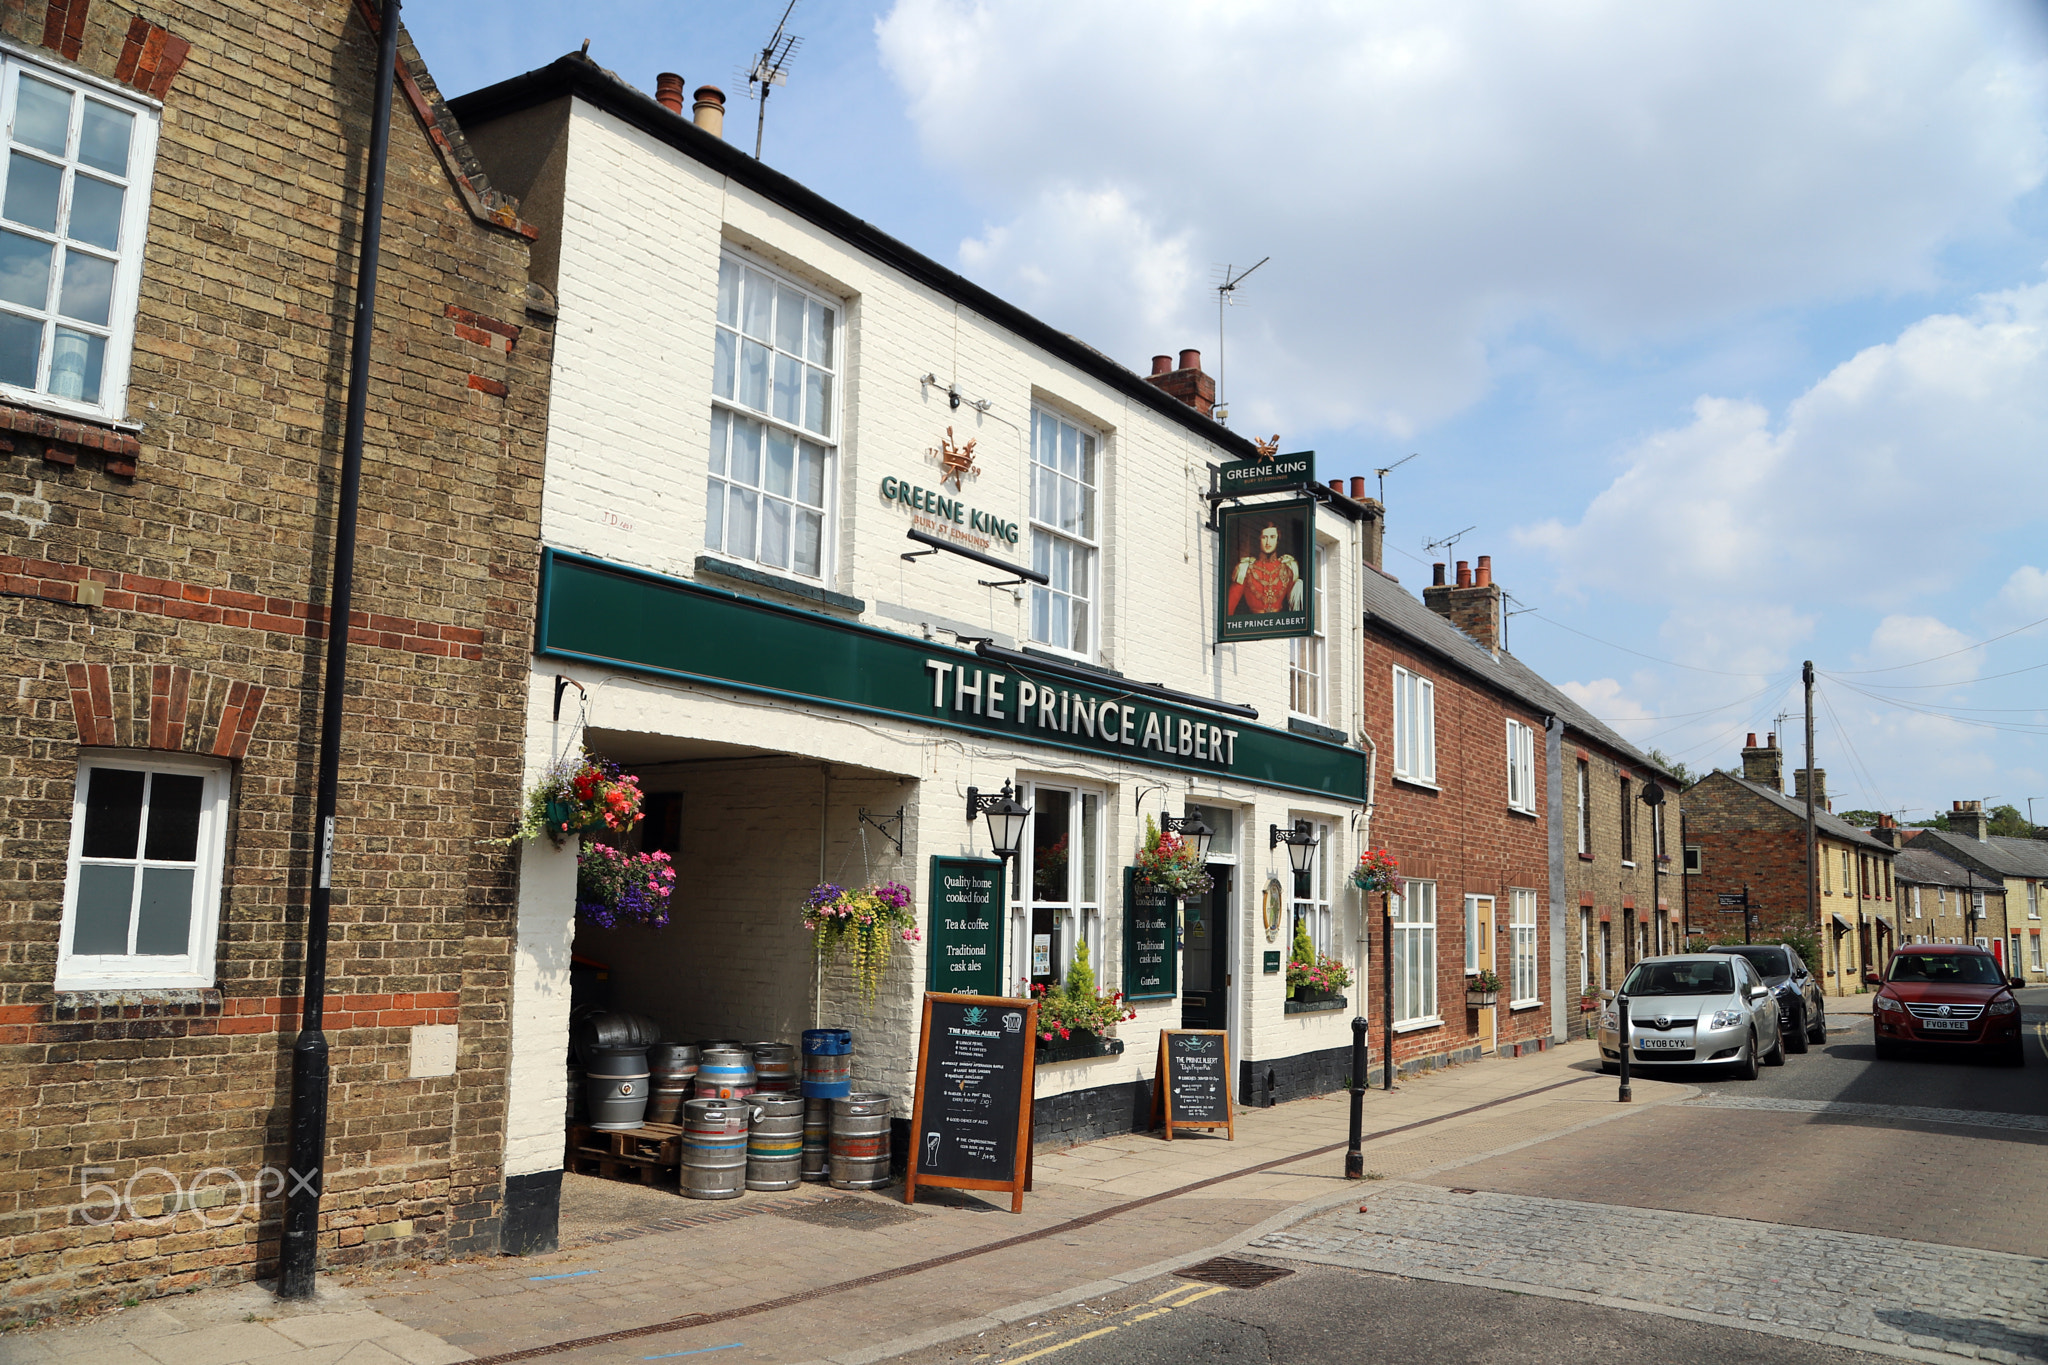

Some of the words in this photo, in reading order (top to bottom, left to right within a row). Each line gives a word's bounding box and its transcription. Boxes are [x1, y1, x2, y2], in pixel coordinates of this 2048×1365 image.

[928, 448, 938, 458] 17
[972, 466, 981, 476] 99
[1226, 465, 1272, 480] GREENE
[1276, 461, 1307, 474] KING
[882, 476, 964, 524] GREENE
[971, 508, 1018, 543] KING
[914, 515, 936, 529] BURY
[938, 524, 948, 534] ST
[951, 528, 990, 549] EDMUNDS
[1244, 619, 1274, 628] PRINCE
[1275, 617, 1306, 626] ALBERT
[926, 659, 1006, 720] THE
[1018, 680, 1136, 746] PRINCE
[1142, 712, 1238, 765] ALBERT
[944, 876, 971, 890] Quality
[972, 876, 992, 888] home
[946, 891, 972, 903] cooked
[973, 892, 989, 903] food
[1155, 896, 1166, 906] food
[945, 919, 959, 930] Tea
[960, 920, 966, 930] &
[968, 918, 989, 930] coffee
[1136, 920, 1145, 928] Tea
[1146, 920, 1150, 928] &
[1151, 919, 1166, 929] coffee
[946, 944, 986, 956] Traditional
[1137, 940, 1164, 950] Traditional
[1140, 954, 1151, 963] cask
[1152, 954, 1162, 963] ales
[950, 960, 966, 971] cask
[968, 960, 981, 971] ales
[1140, 976, 1160, 986] Garden
[441, 1055, 450, 1066] 2
